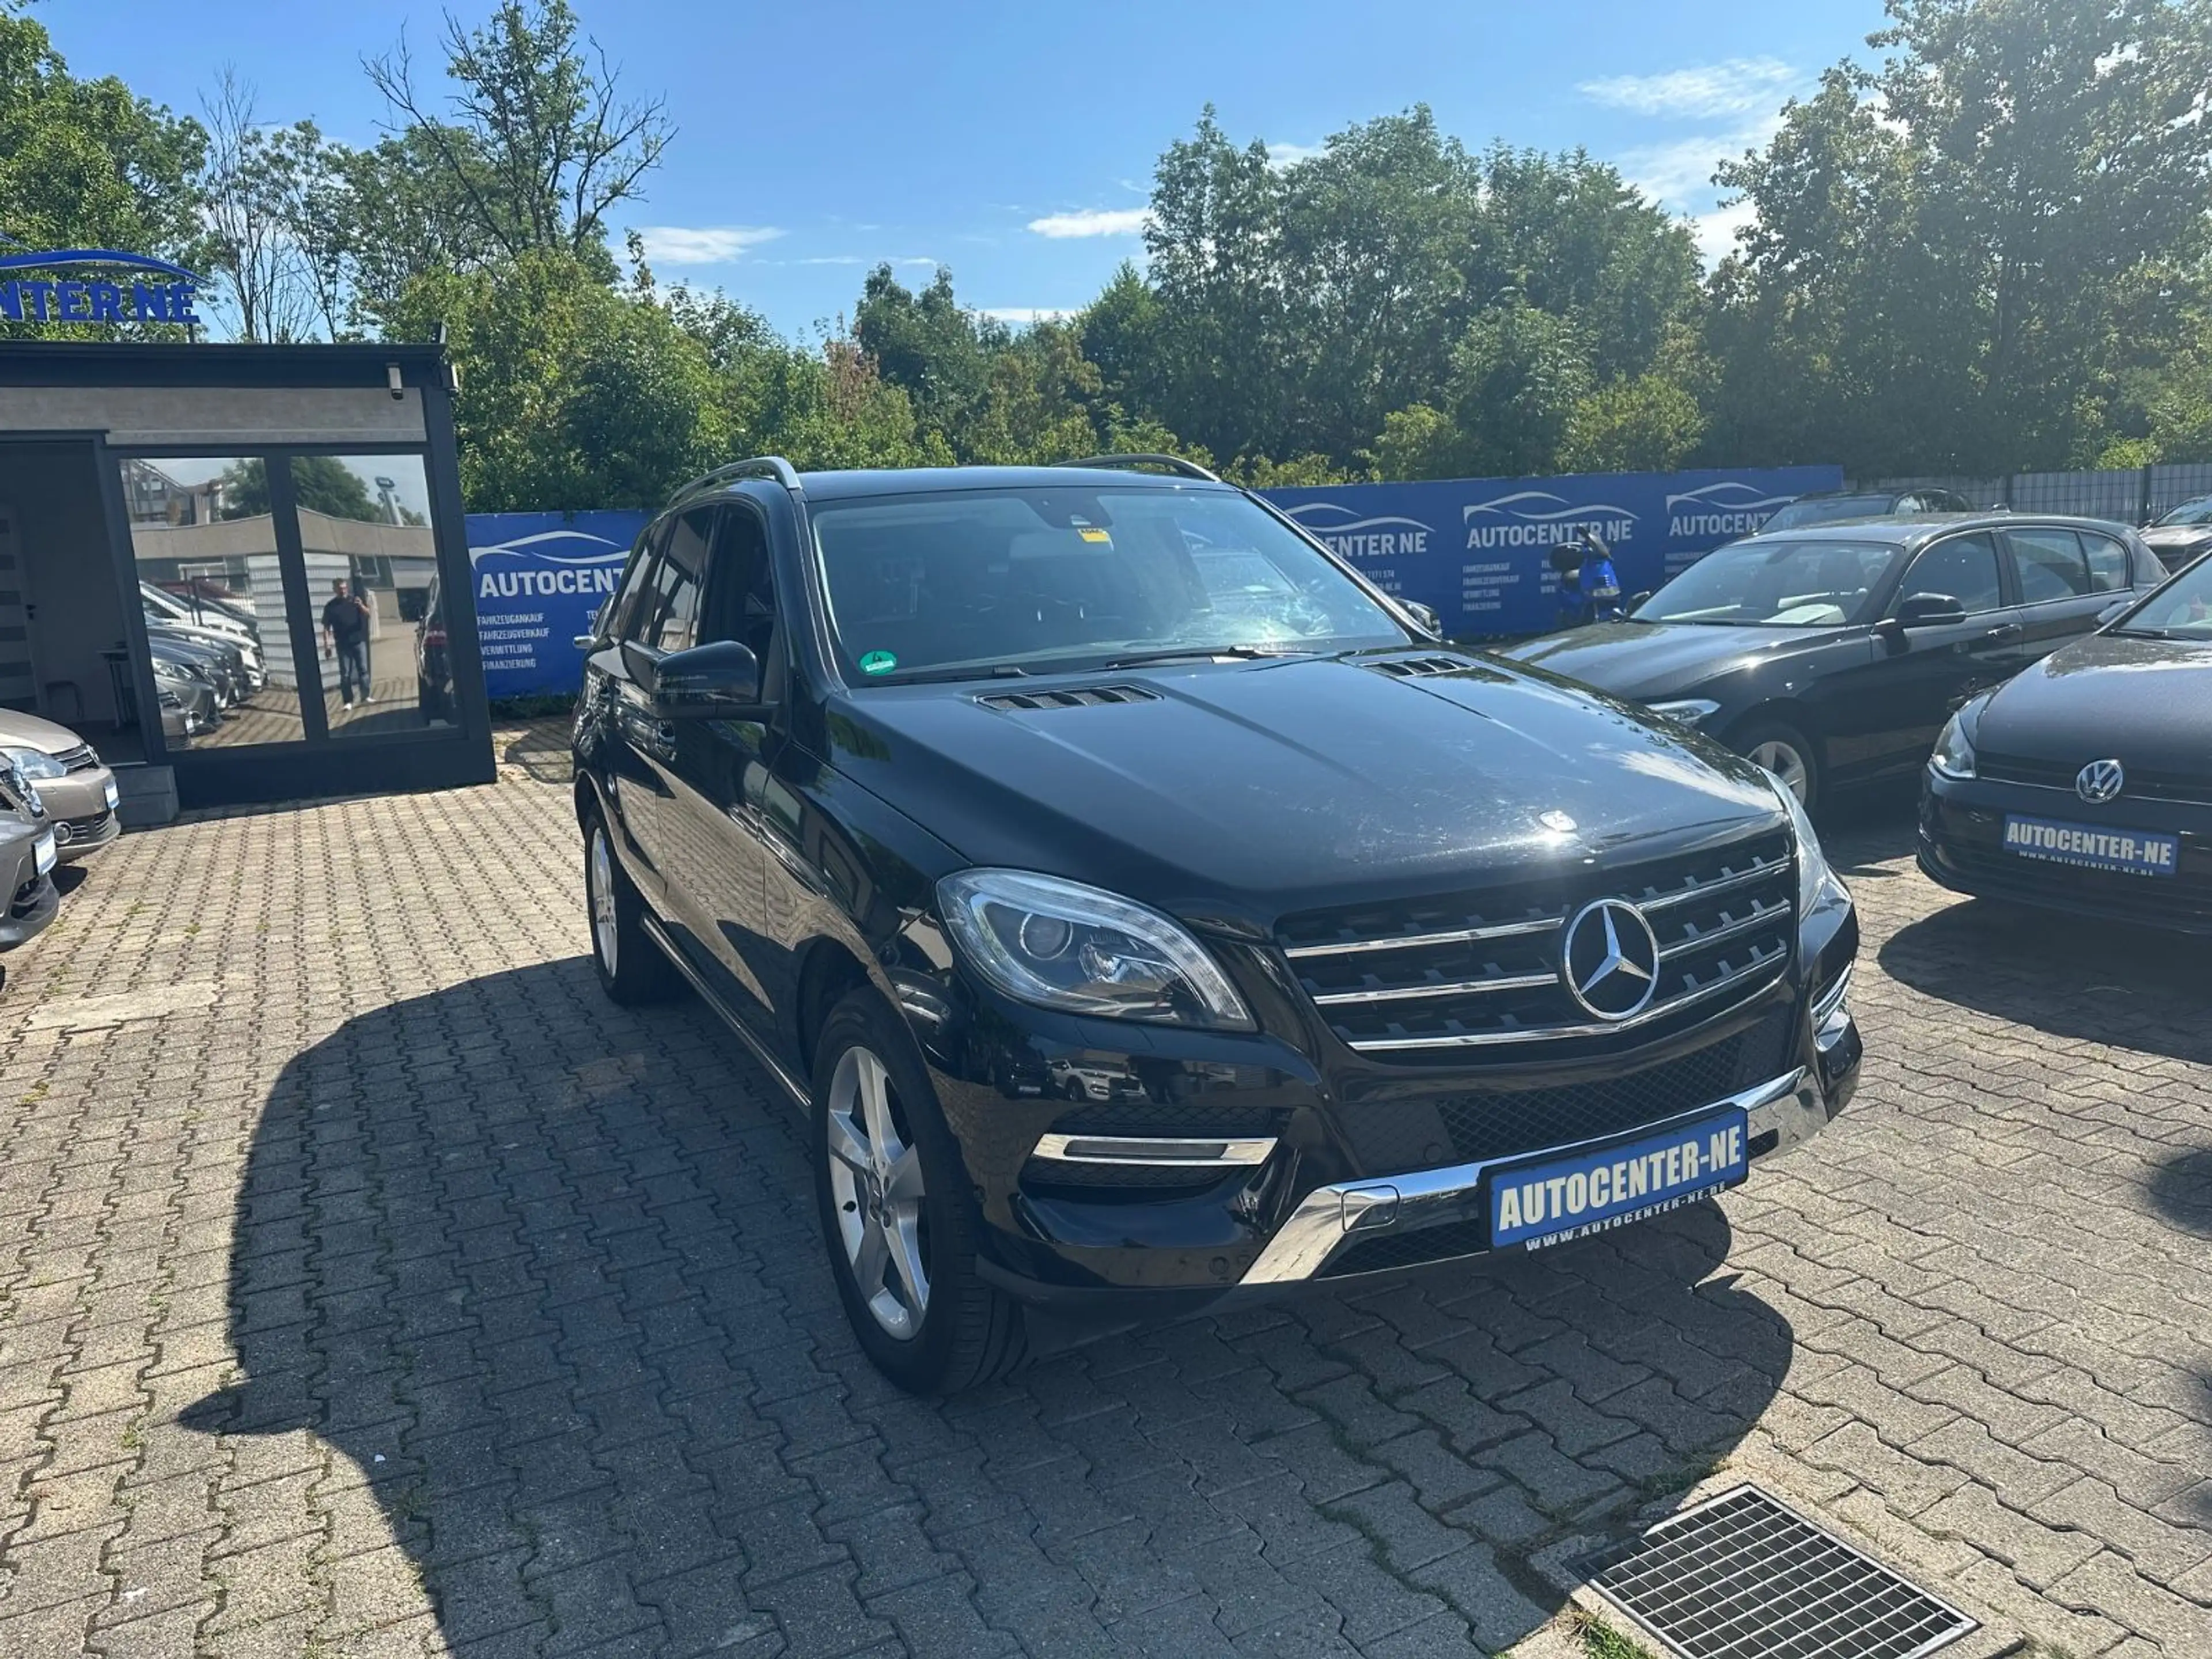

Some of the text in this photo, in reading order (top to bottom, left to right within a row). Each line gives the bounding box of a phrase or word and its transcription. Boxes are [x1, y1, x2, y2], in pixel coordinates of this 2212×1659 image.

[1607, 520, 1633, 541] NE
[1399, 531, 1427, 554] NE
[477, 612, 544, 626] FAHRZEUGANKAUF
[478, 627, 550, 641] FAHRZEUGVERKAUF
[480, 643, 533, 656] VERMITTLUNG
[482, 658, 536, 671] FINANZIERUNG
[2007, 822, 2171, 865] AUTOCENTER-NE
[1498, 1124, 1741, 1232] AUTOCENTER-NE
[1525, 1180, 1725, 1251] WWW.AUTOCENTER-NE.DE
